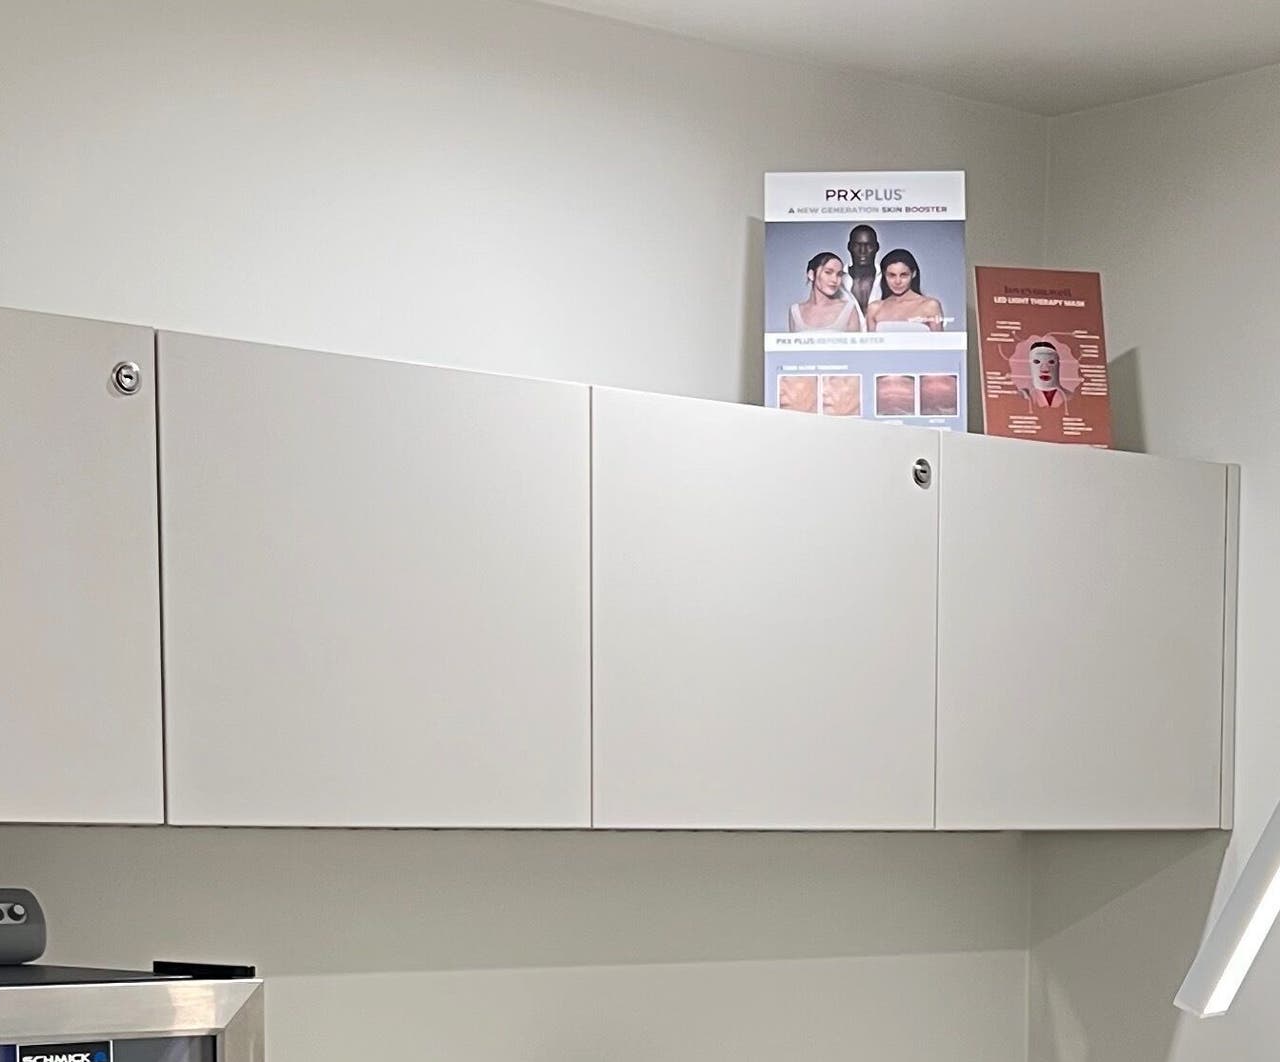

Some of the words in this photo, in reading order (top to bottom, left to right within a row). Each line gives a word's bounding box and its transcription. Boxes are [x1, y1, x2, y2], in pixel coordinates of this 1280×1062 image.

[993, 296, 1007, 304] LED
[1008, 297, 1029, 305] LIGHT
[1030, 298, 1063, 307] THERAPY
